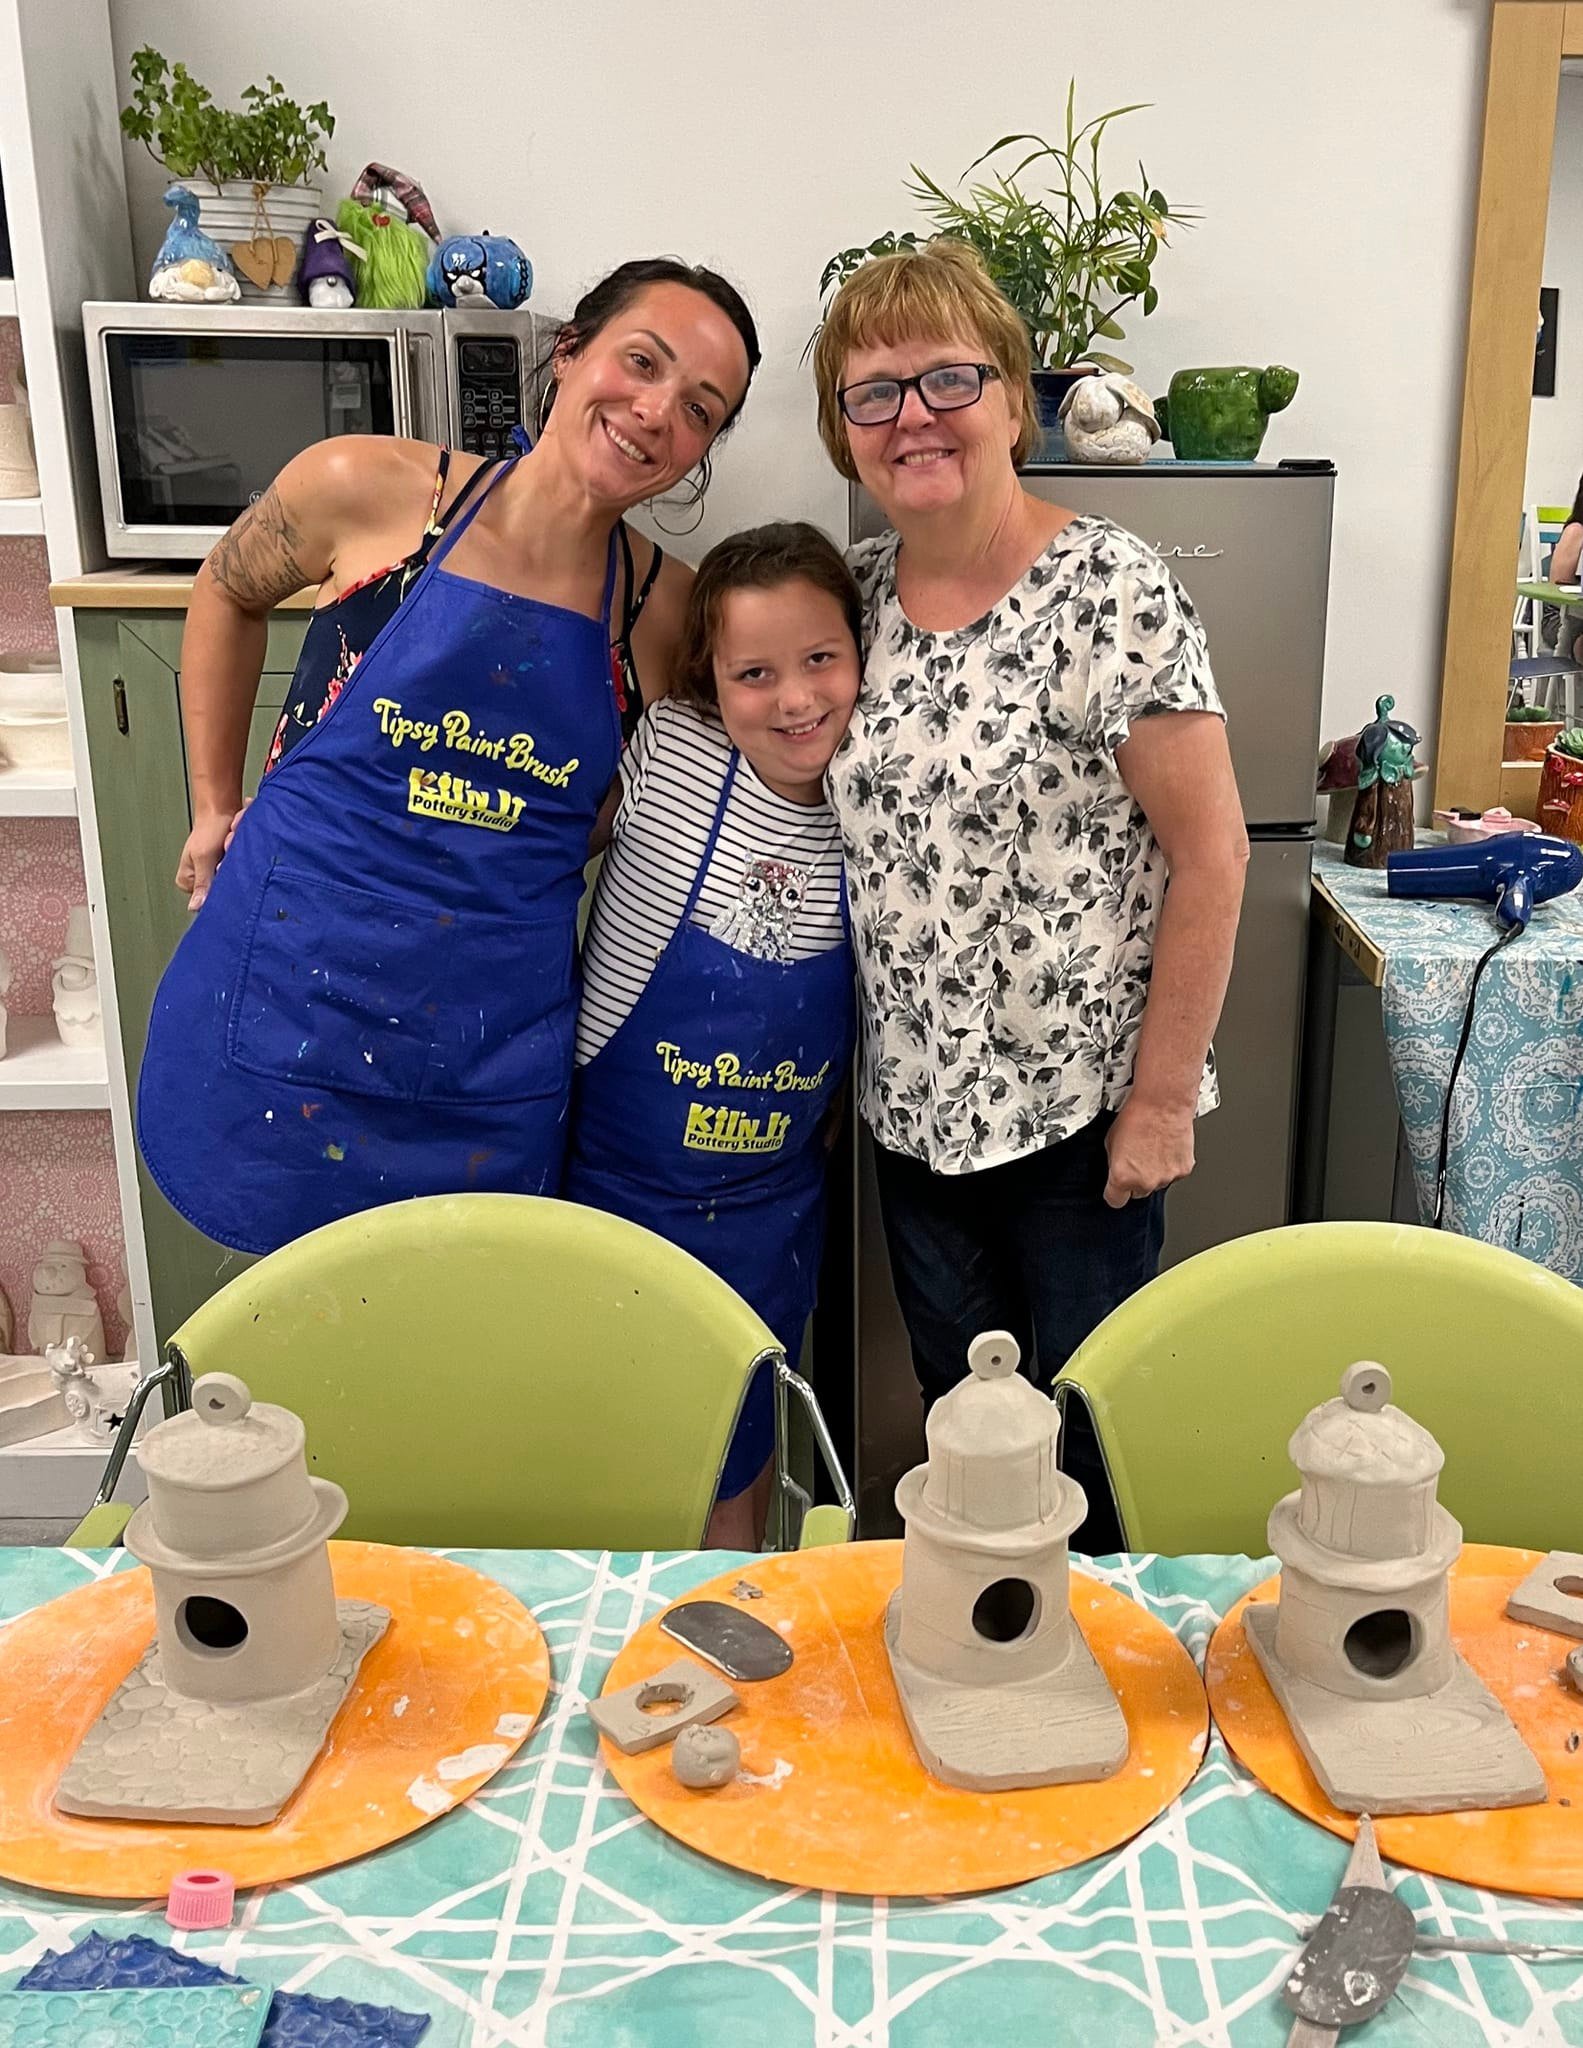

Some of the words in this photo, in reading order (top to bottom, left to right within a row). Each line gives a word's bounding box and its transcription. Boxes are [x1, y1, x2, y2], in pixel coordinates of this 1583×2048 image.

[373, 698, 438, 751] Tipsy
[442, 710, 506, 760] Paint
[505, 733, 579, 788] Brush
[413, 794, 468, 819] Pottery
[470, 810, 514, 828] Studio
[656, 1041, 712, 1088] Tipsy
[715, 1052, 773, 1089] Paint
[773, 1060, 829, 1092] Brush
[688, 1132, 739, 1150] Pottery
[742, 1138, 782, 1150] Studio
[766, 1112, 792, 1137] It
